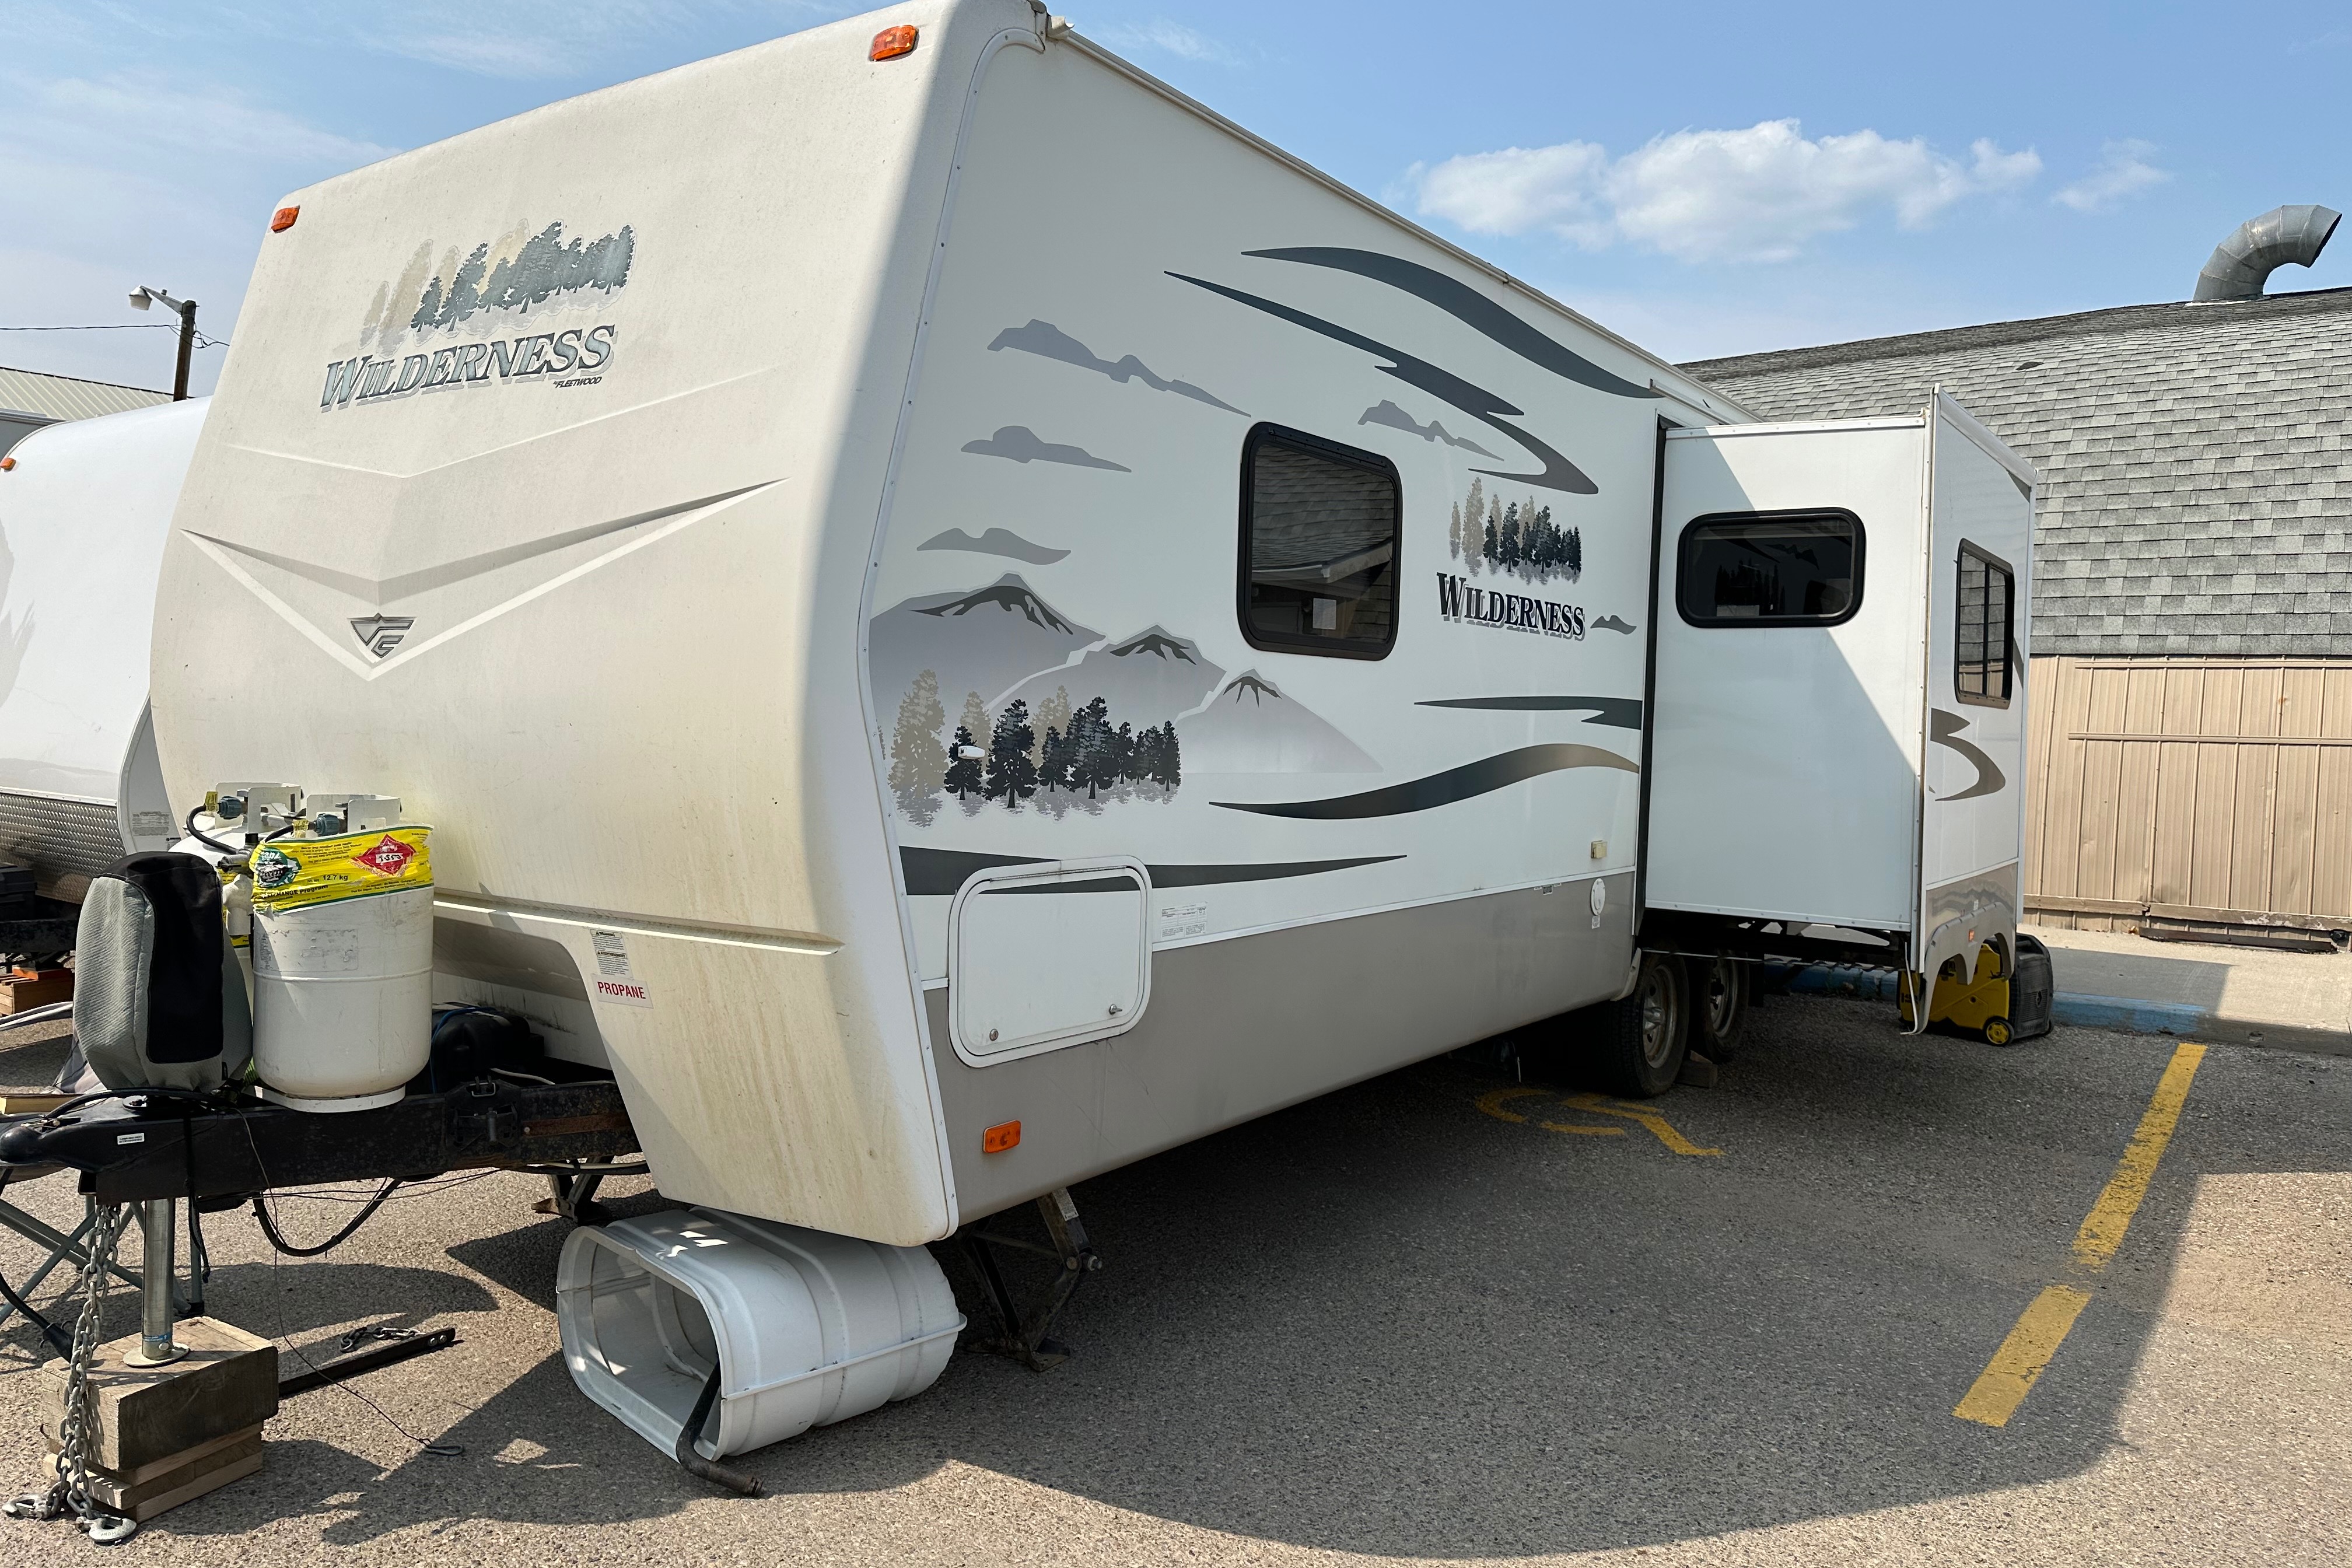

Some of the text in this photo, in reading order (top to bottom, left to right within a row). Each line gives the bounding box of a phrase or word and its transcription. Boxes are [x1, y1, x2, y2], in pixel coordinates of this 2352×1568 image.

[320, 324, 615, 408] WILDERNESS
[555, 376, 603, 388] FLEETWOOD
[1436, 572, 1584, 636] WILDERNESS
[300, 885, 328, 894] Program
[597, 981, 646, 999] PROPANE
